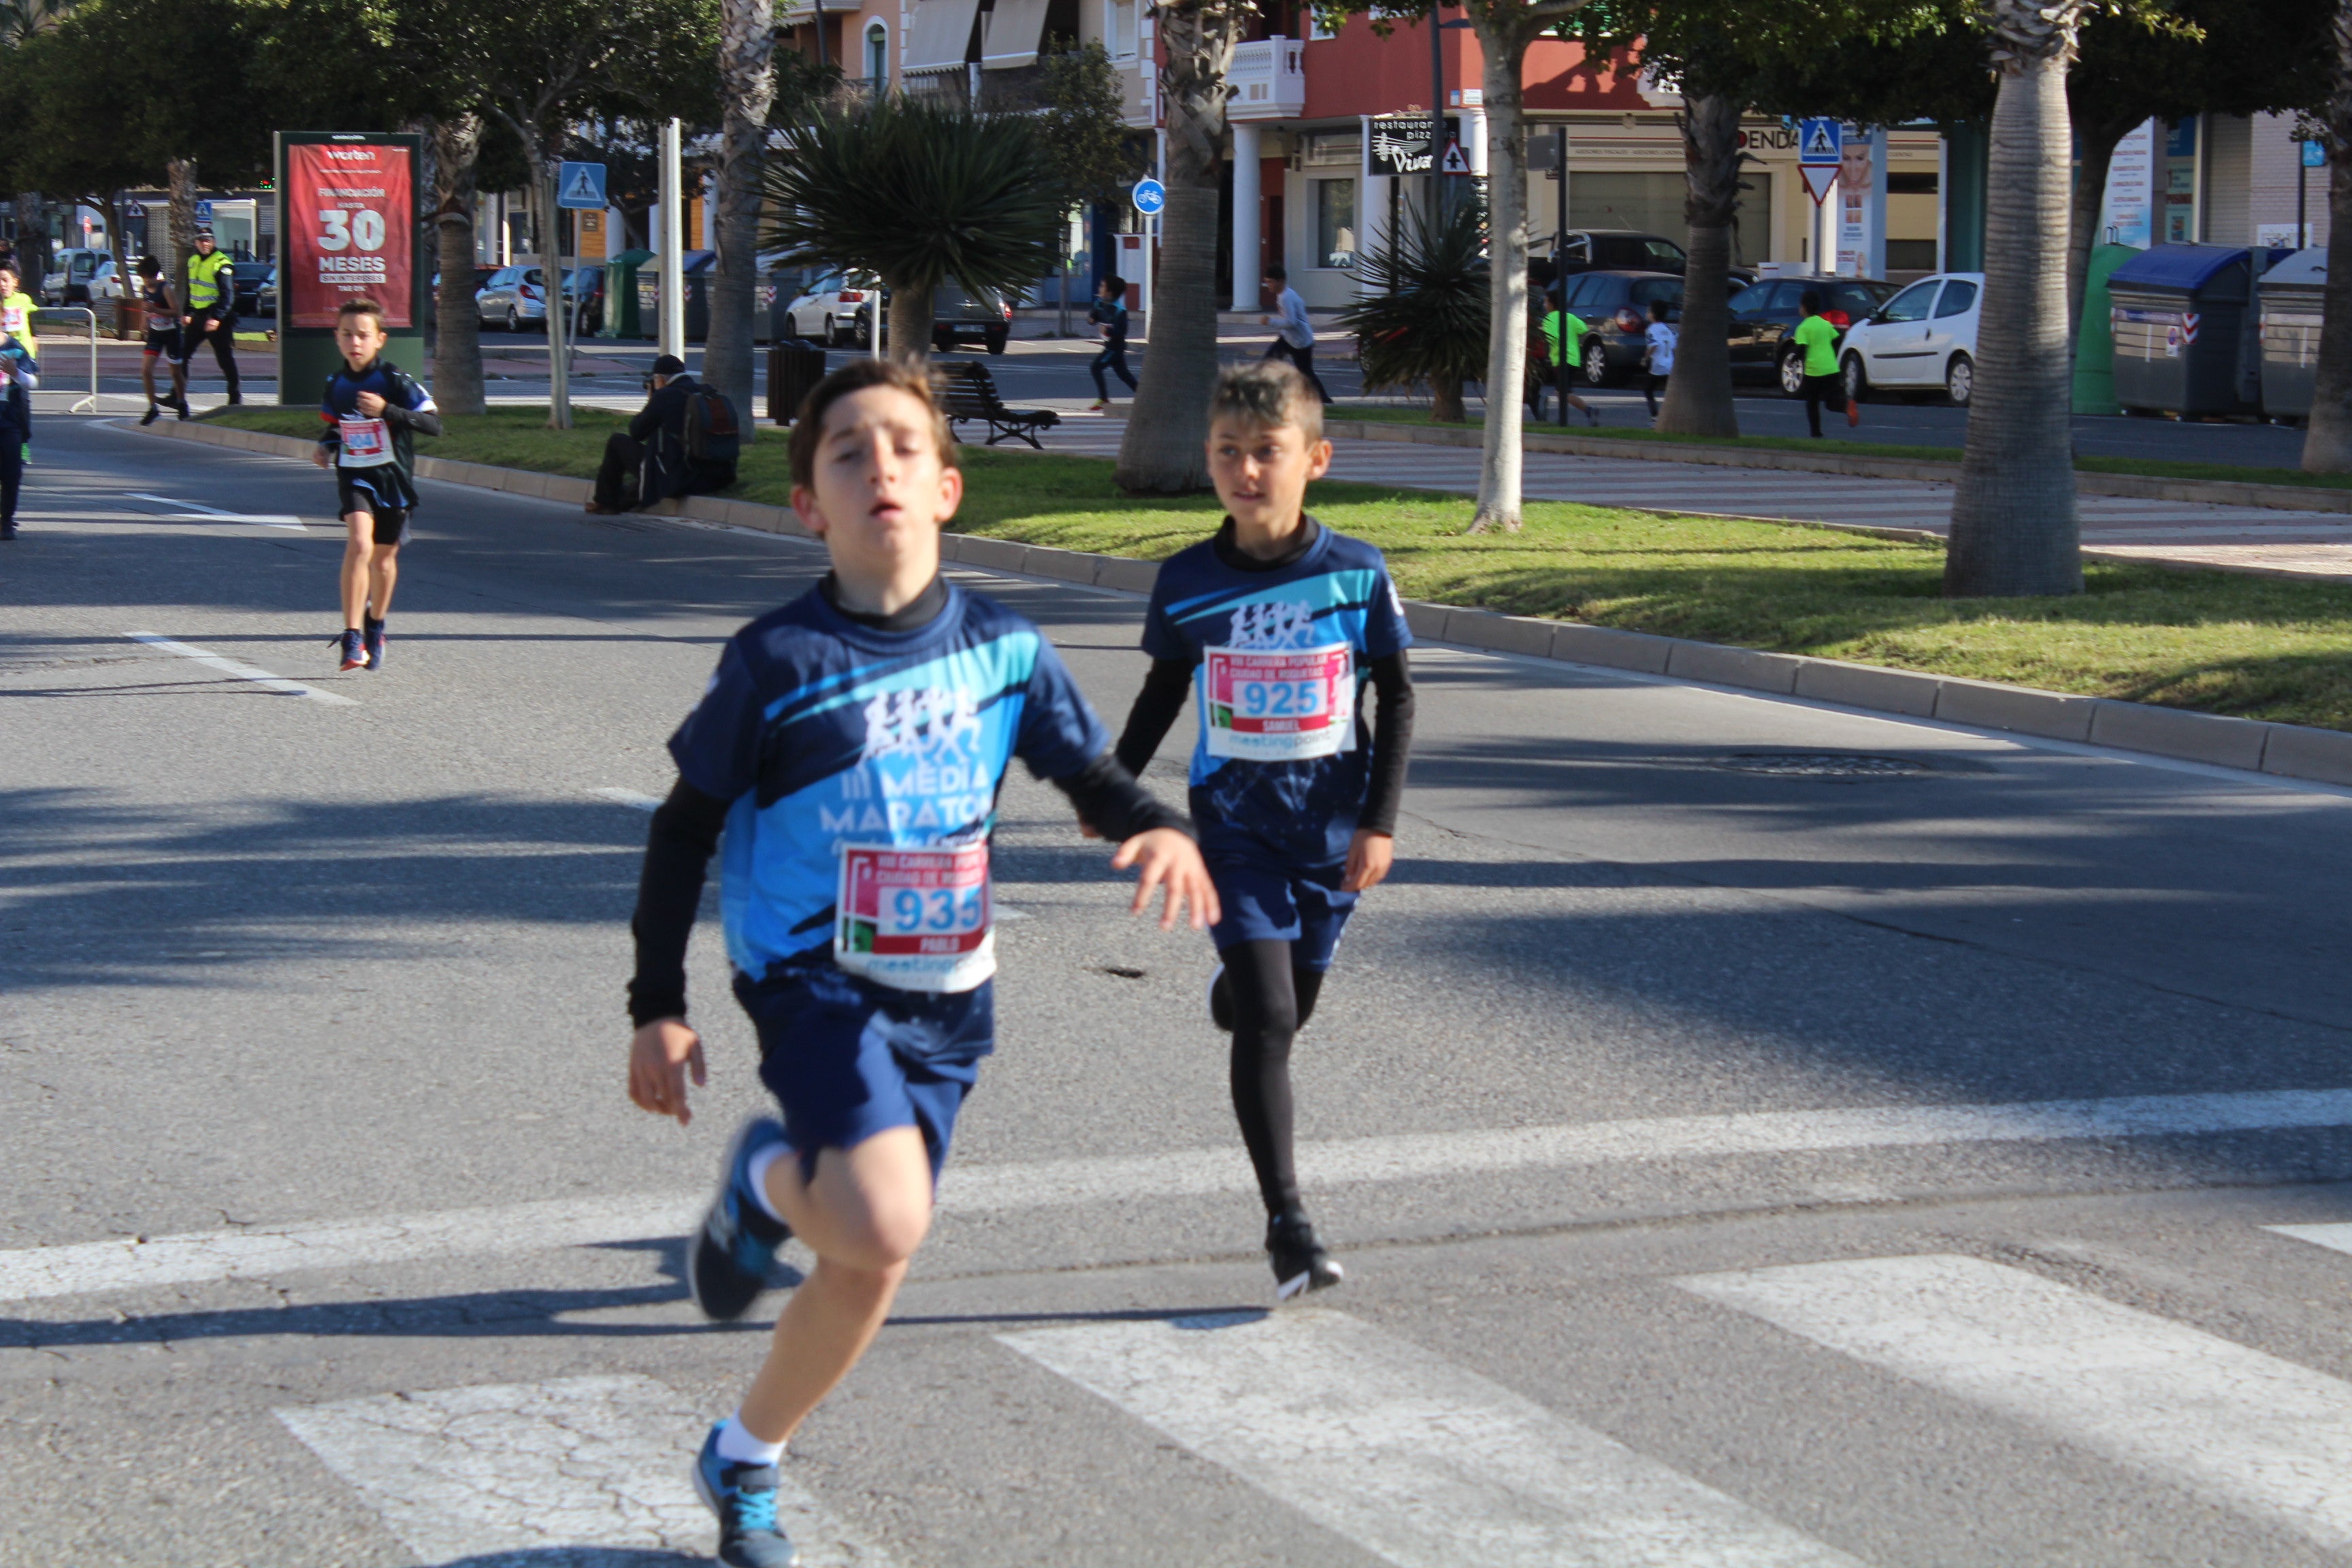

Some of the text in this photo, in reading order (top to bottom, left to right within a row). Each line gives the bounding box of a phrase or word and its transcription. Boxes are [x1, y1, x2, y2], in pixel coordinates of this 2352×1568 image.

[327, 150, 376, 161] worten
[318, 186, 385, 197] FINANCIACIÓN
[318, 210, 386, 251] 30
[318, 257, 387, 272] MESES
[1246, 656, 1287, 667] CARRERA
[1288, 654, 1327, 666] POPULAR
[1230, 668, 1262, 679] CIUDAD
[1264, 668, 1276, 679] DE
[1245, 682, 1318, 714] 925
[1262, 719, 1301, 732] SAMUEL
[920, 936, 960, 952] PABLO
